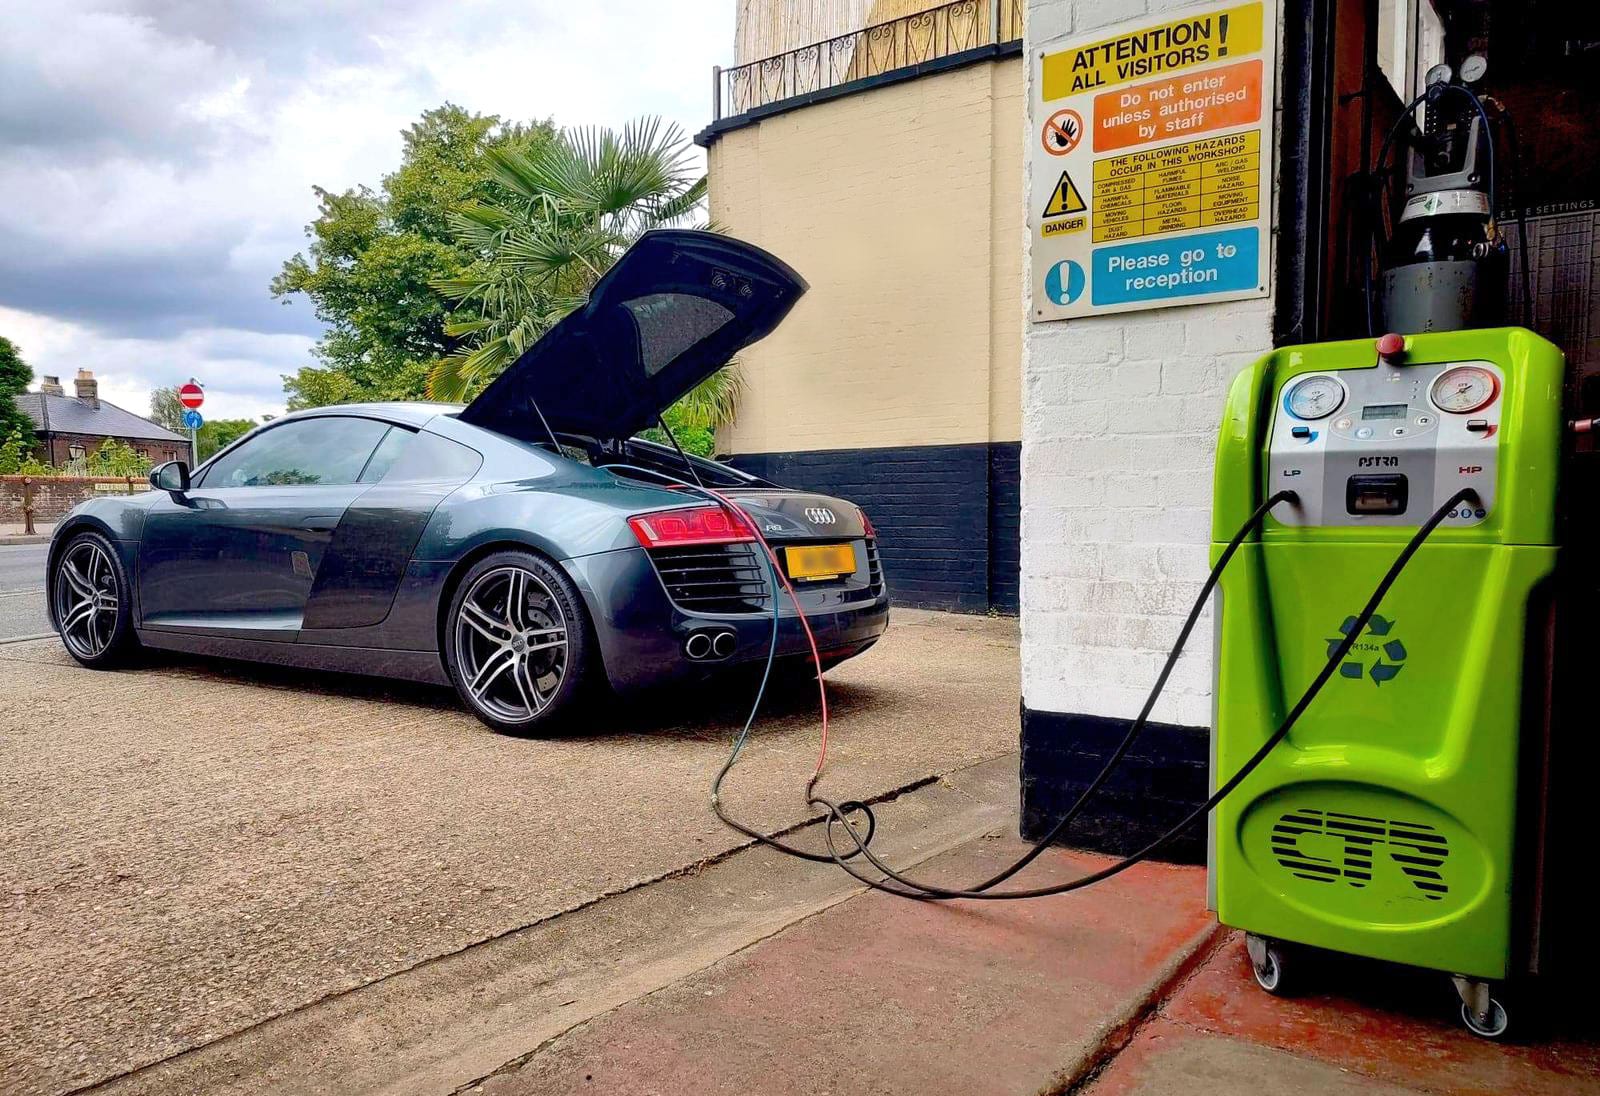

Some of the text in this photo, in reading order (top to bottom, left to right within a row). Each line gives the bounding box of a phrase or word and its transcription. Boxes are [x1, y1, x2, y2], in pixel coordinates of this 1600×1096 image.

[1072, 44, 1210, 92] ALL VISITORS
[1120, 75, 1226, 108] Do not enter
[1103, 86, 1247, 128] unless authorised
[1139, 112, 1205, 139] by staff
[1110, 135, 1246, 167] THE FOLLOWING HAZARDS
[1110, 145, 1246, 177] OCCUR IN THIS WORKSHOP
[1235, 157, 1249, 165] GAS
[1158, 169, 1186, 177] HARMFUL
[1217, 164, 1246, 174] WELDING
[1097, 177, 1136, 189] COMPRESSED
[1162, 175, 1183, 183] FUMES
[1221, 175, 1241, 183] NOISE
[1119, 184, 1131, 192] GAS
[1153, 183, 1191, 194] FLAMMABLE
[1217, 181, 1245, 190] HAZARD
[1102, 194, 1129, 203] HARMFUL
[1155, 189, 1189, 200] MATERIALS
[1218, 191, 1244, 200] MOVING
[1100, 199, 1132, 210] CHEMICALS
[1162, 201, 1182, 209] FLOOR
[1212, 196, 1249, 207] EQUIPMENT
[1157, 206, 1187, 215] HAZARDS
[1213, 206, 1248, 216] OVERHEAD
[1536, 199, 1595, 215] SETTINGS
[1105, 209, 1127, 217] MOVING
[1214, 213, 1246, 223] HAZARDS
[1103, 215, 1129, 224] VEHICLES
[1045, 219, 1084, 233] DANGER
[1108, 225, 1123, 233] DUST
[1159, 222, 1186, 231] GRINDING
[1104, 231, 1128, 240] HAZARD
[1108, 243, 1237, 272] Please go to
[1126, 268, 1218, 290] reception
[1358, 456, 1399, 467] ASTRA
[1283, 469, 1302, 477] LP
[1458, 466, 1483, 474] HP
[1352, 642, 1379, 651] R134a
